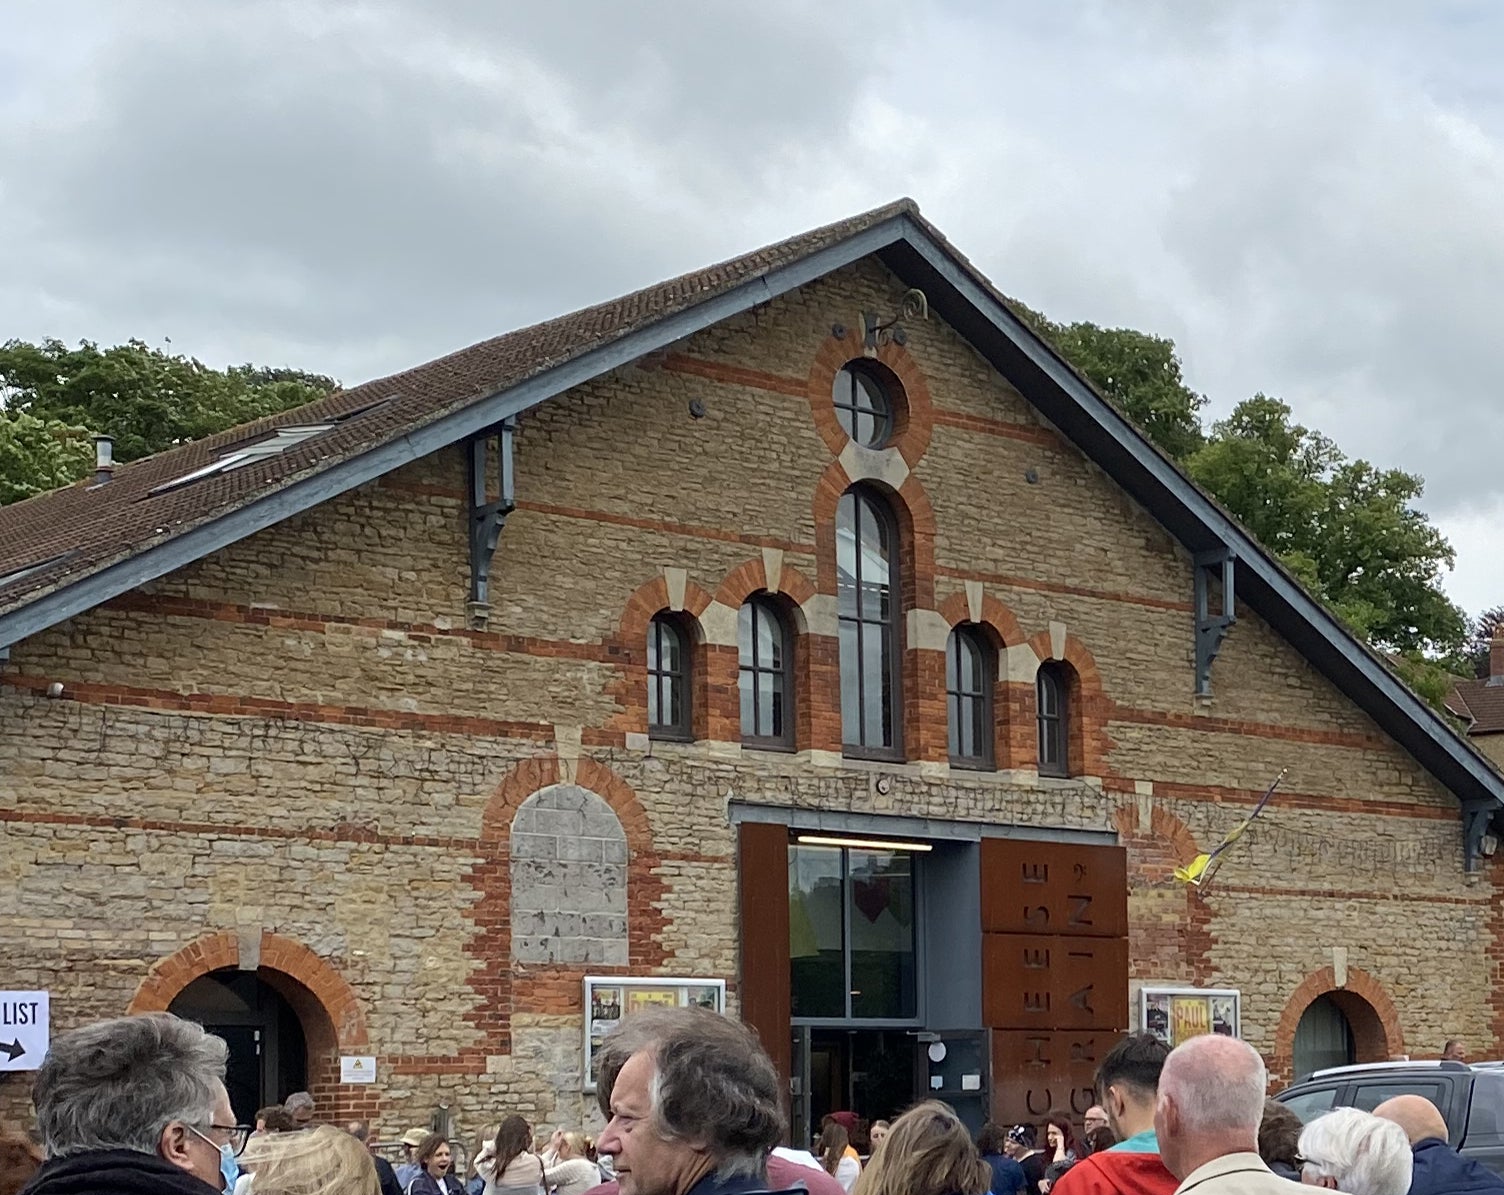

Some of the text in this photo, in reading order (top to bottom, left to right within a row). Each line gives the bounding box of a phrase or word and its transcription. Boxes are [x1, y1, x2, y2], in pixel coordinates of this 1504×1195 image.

[3, 1002, 39, 1025] LIST
[1022, 863, 1052, 1116] CHEESE
[1067, 894, 1095, 1114] GRAIN
[1176, 1006, 1206, 1028] PAUL
